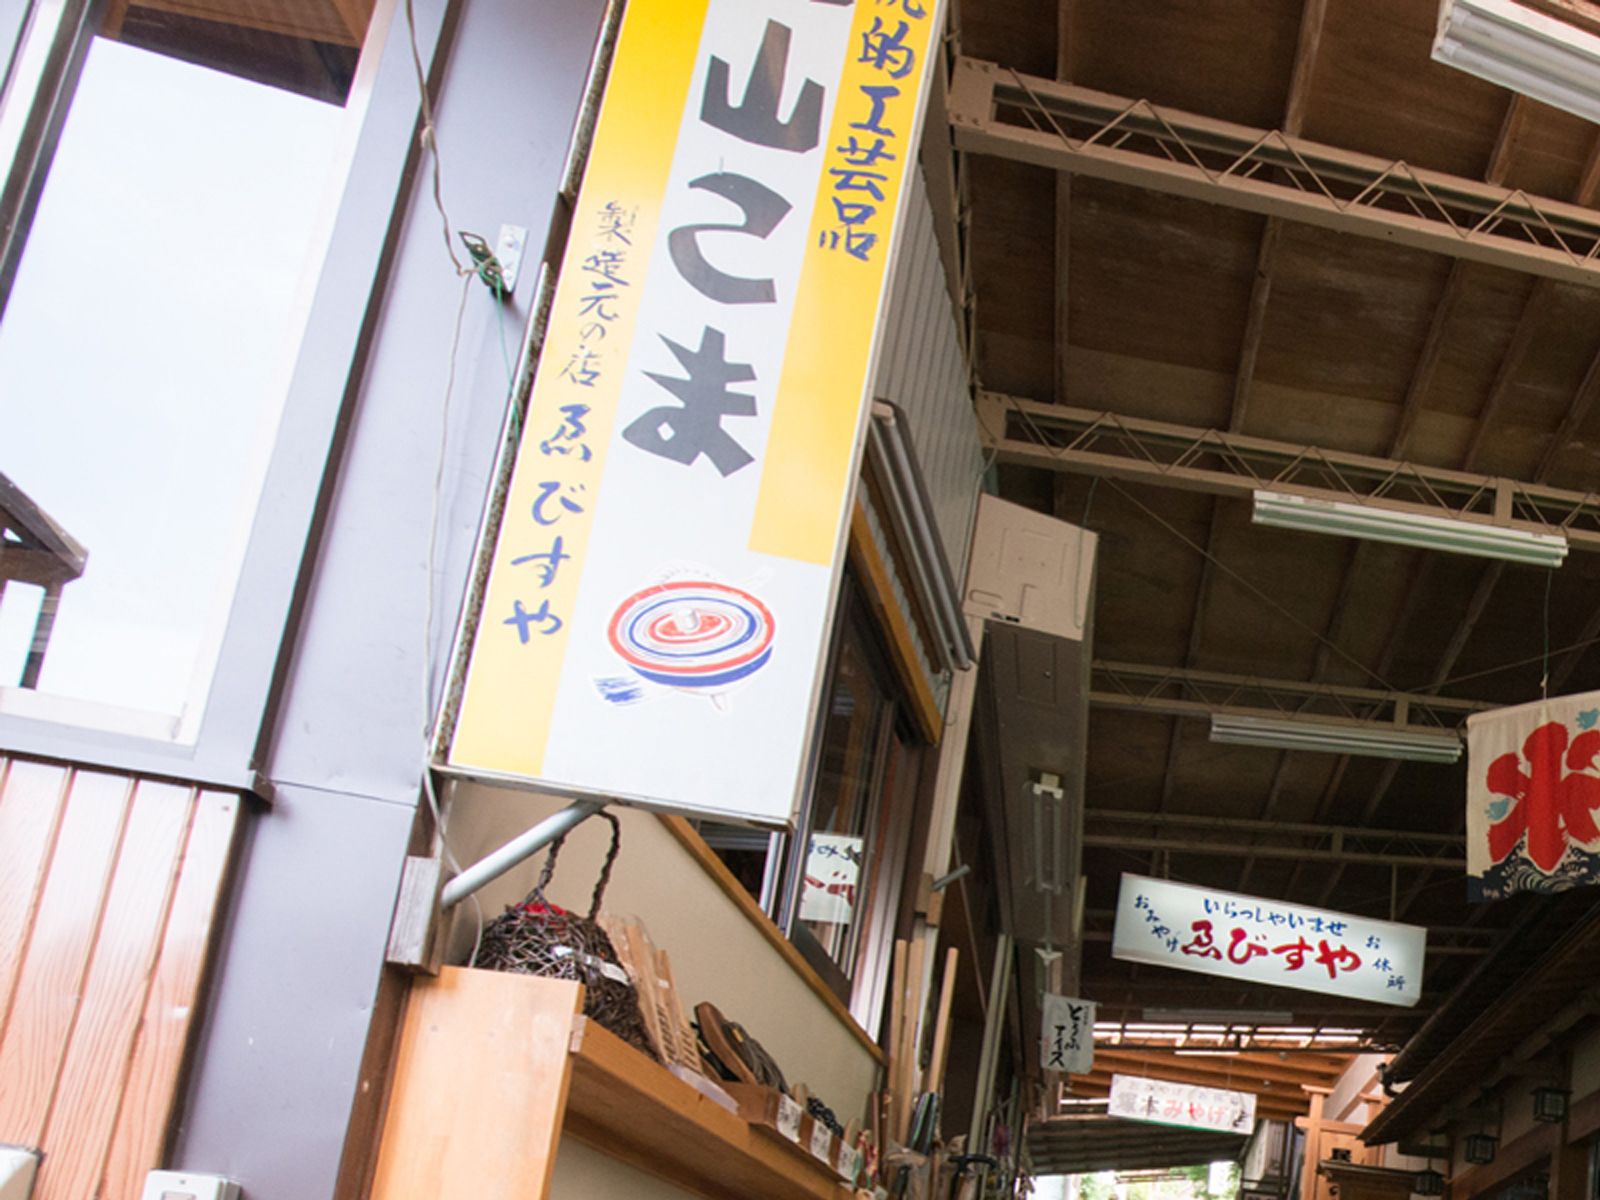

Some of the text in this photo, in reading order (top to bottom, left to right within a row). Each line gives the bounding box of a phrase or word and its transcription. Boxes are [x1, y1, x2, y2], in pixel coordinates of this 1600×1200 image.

[819, 0, 926, 261] 的工芸品
[622, 0, 851, 477] 山こま
[1181, 919, 1362, 980] ゑびすや
[1203, 898, 1347, 937] いらっしゃいませ
